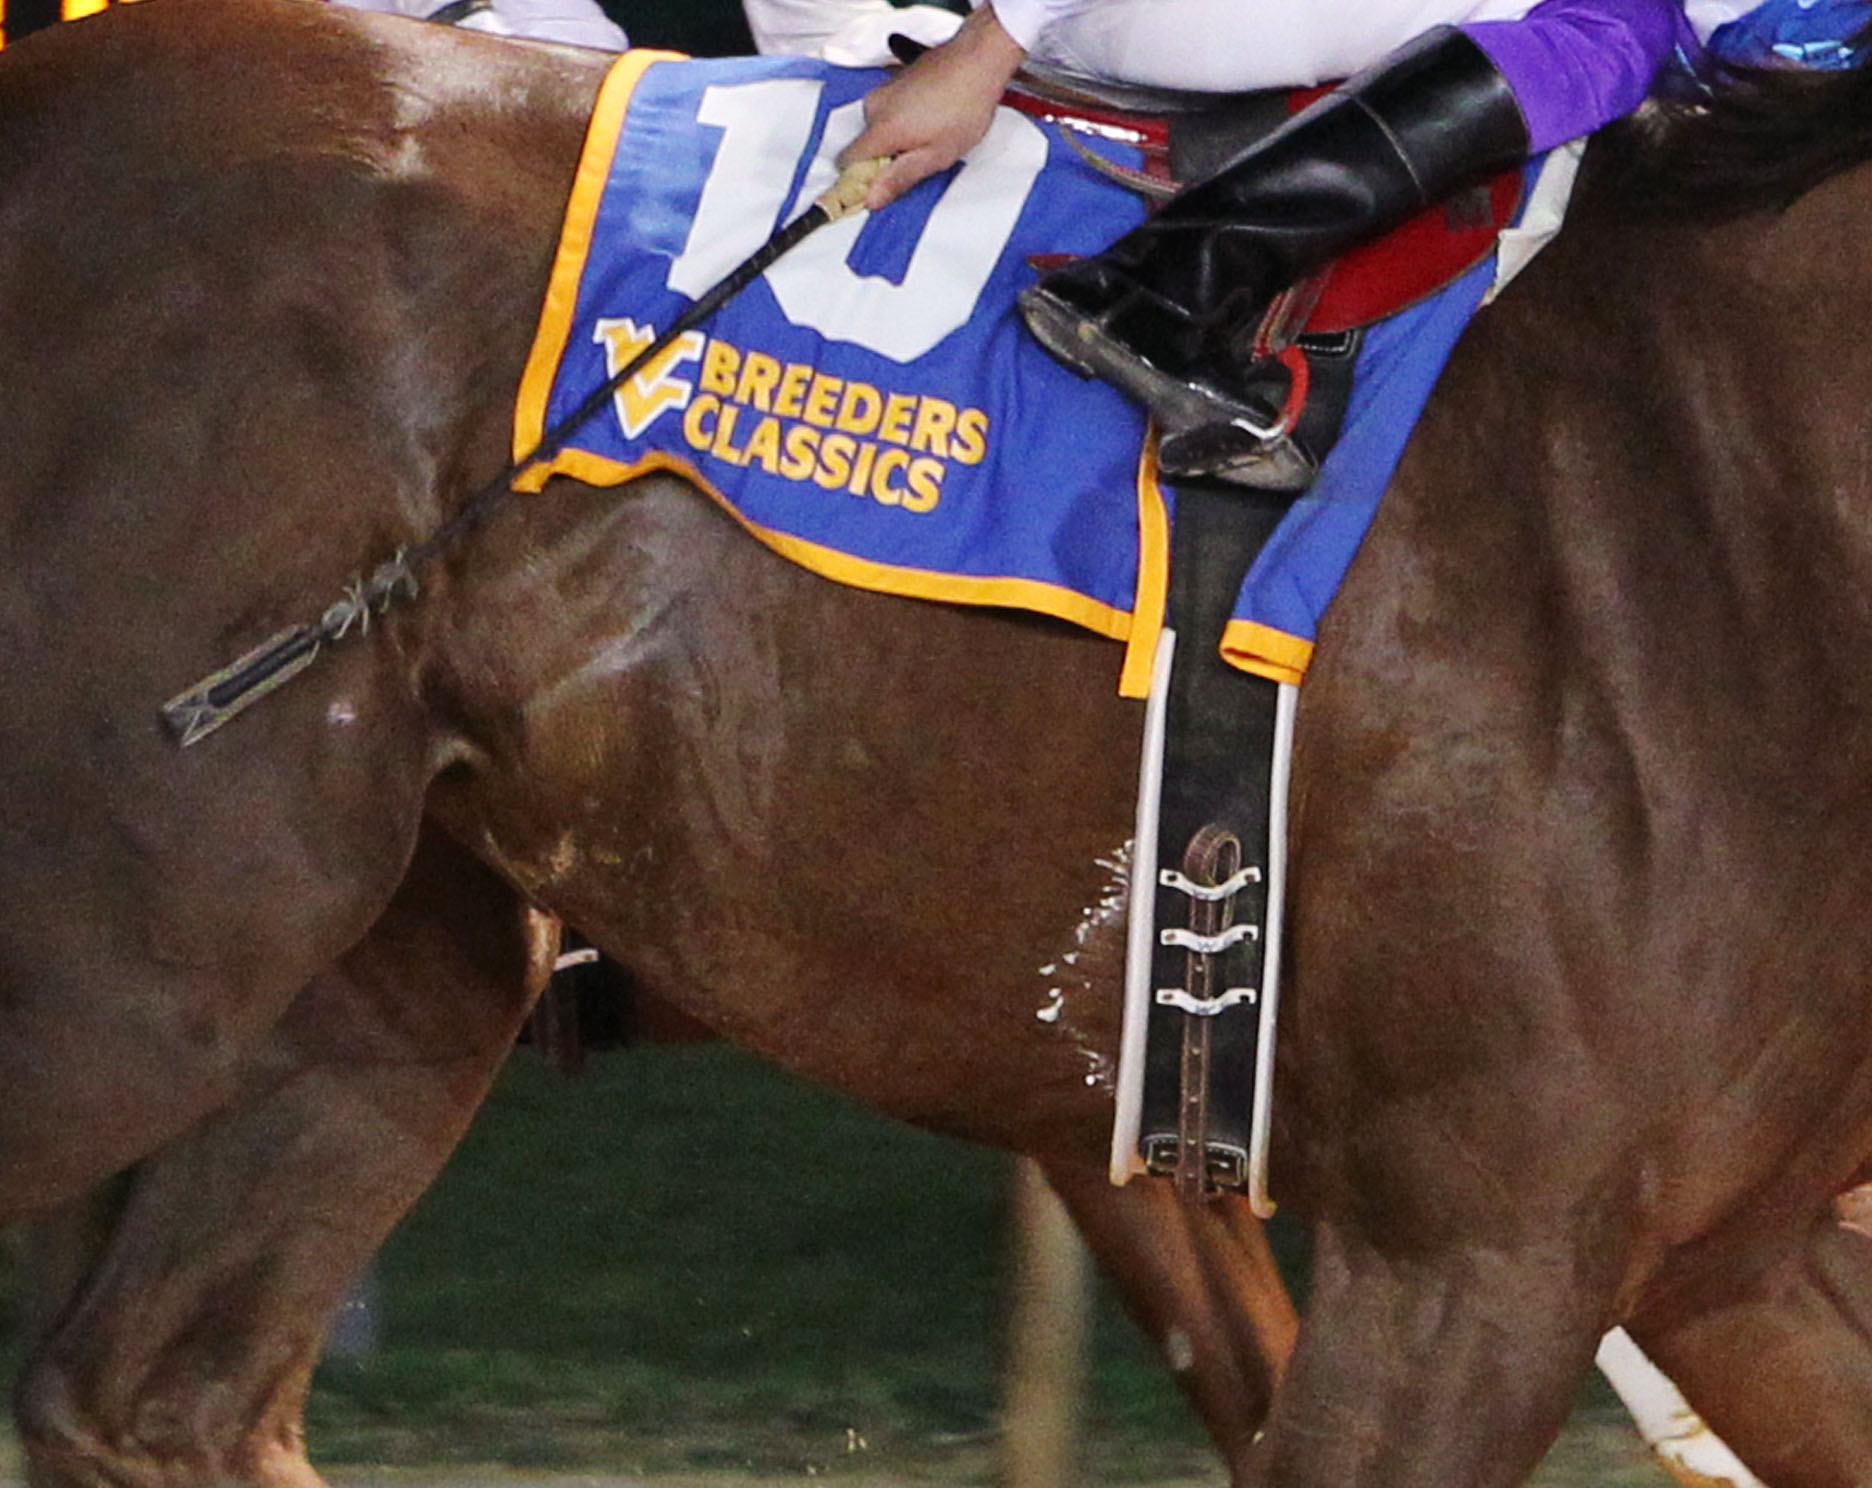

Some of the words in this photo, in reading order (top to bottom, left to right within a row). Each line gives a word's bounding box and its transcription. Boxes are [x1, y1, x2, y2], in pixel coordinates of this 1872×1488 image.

[666, 76, 1050, 364] 10
[682, 394, 948, 514] CLASSICS
[700, 338, 990, 466] BREEDERS
